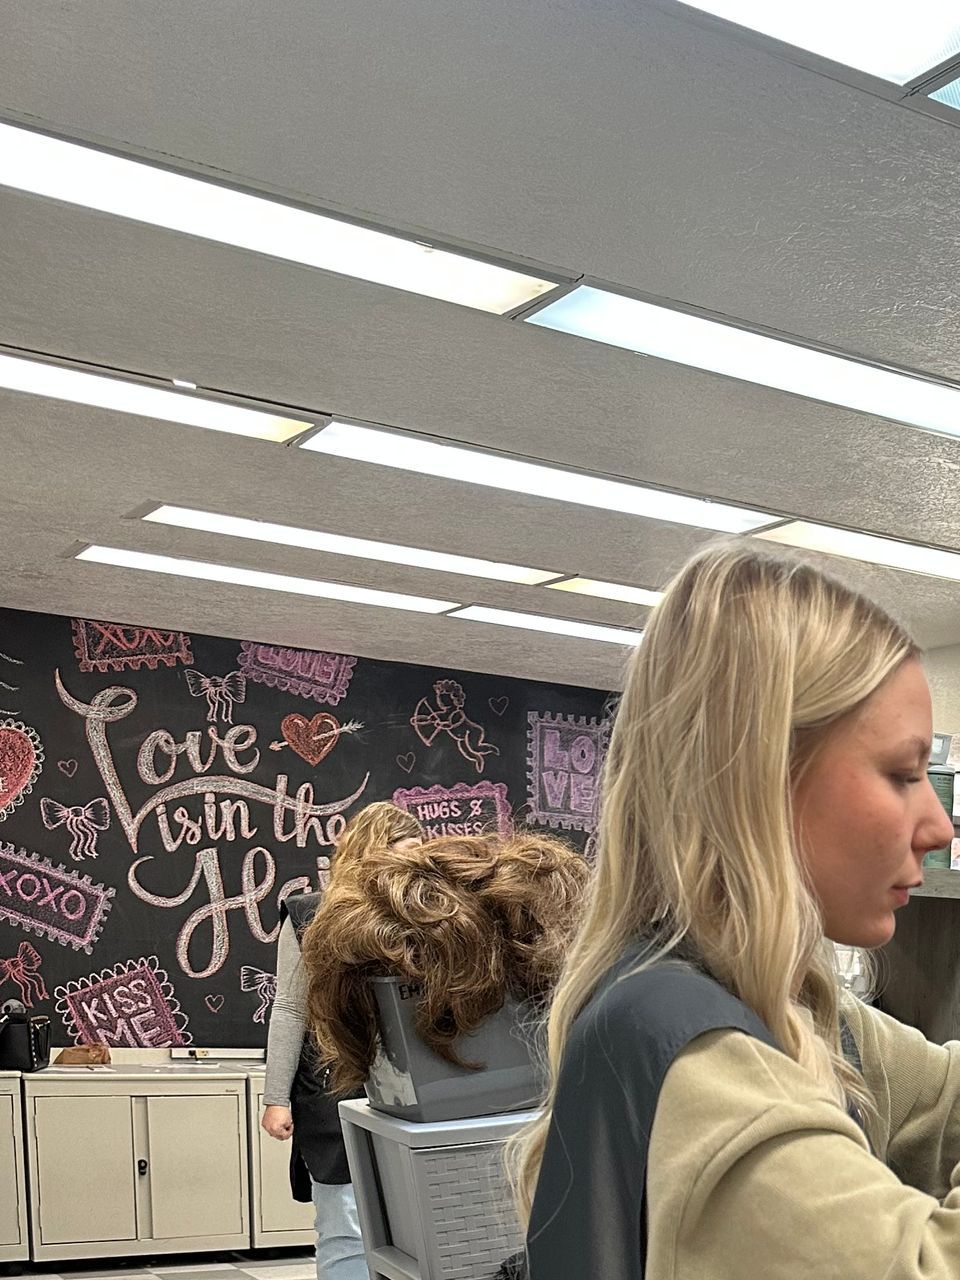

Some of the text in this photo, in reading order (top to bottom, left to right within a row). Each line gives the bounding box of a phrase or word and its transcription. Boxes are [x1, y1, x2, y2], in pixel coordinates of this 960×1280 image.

[54, 667, 262, 853] Love
[543, 730, 596, 774] LO
[416, 800, 462, 821] HUGS
[541, 770, 595, 813] VE
[155, 802, 202, 852] is
[203, 792, 258, 842] in
[81, 979, 152, 1026] KISS
[96, 1010, 173, 1047] ME
